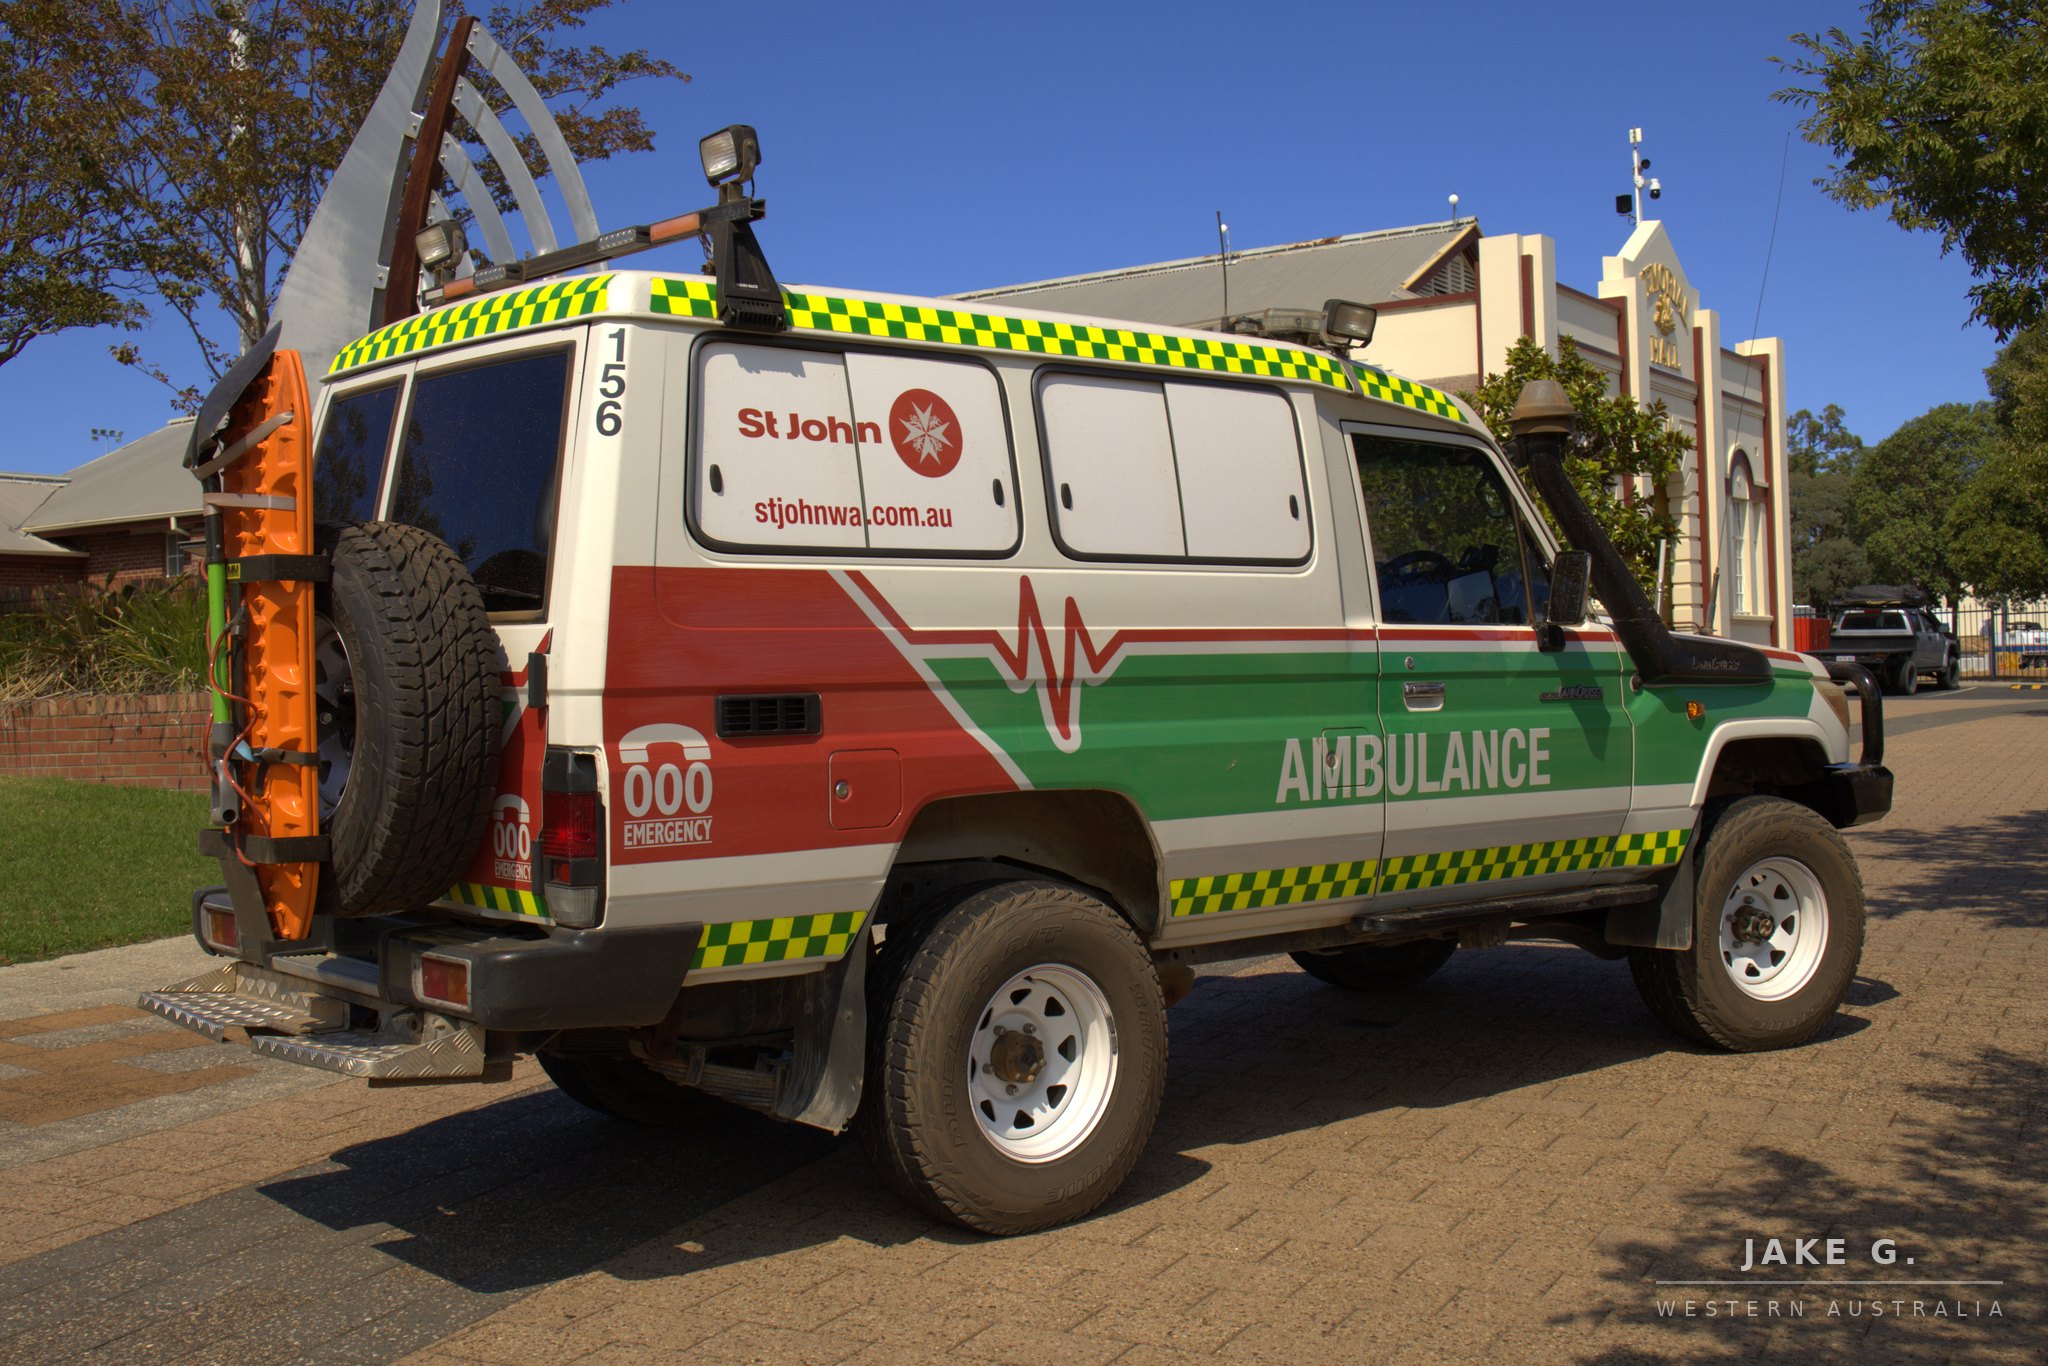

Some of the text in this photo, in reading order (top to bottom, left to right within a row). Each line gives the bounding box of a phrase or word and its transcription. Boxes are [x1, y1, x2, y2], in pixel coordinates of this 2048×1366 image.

[596, 327, 626, 437] 156
[737, 407, 882, 444] St John
[754, 497, 953, 530] stjohnwa.com.au
[1275, 727, 1551, 803] AMBULANCE
[623, 761, 713, 818] 000
[493, 820, 531, 861] 000
[623, 818, 713, 847] EMERGENCY
[494, 861, 532, 882] EMERGENCY
